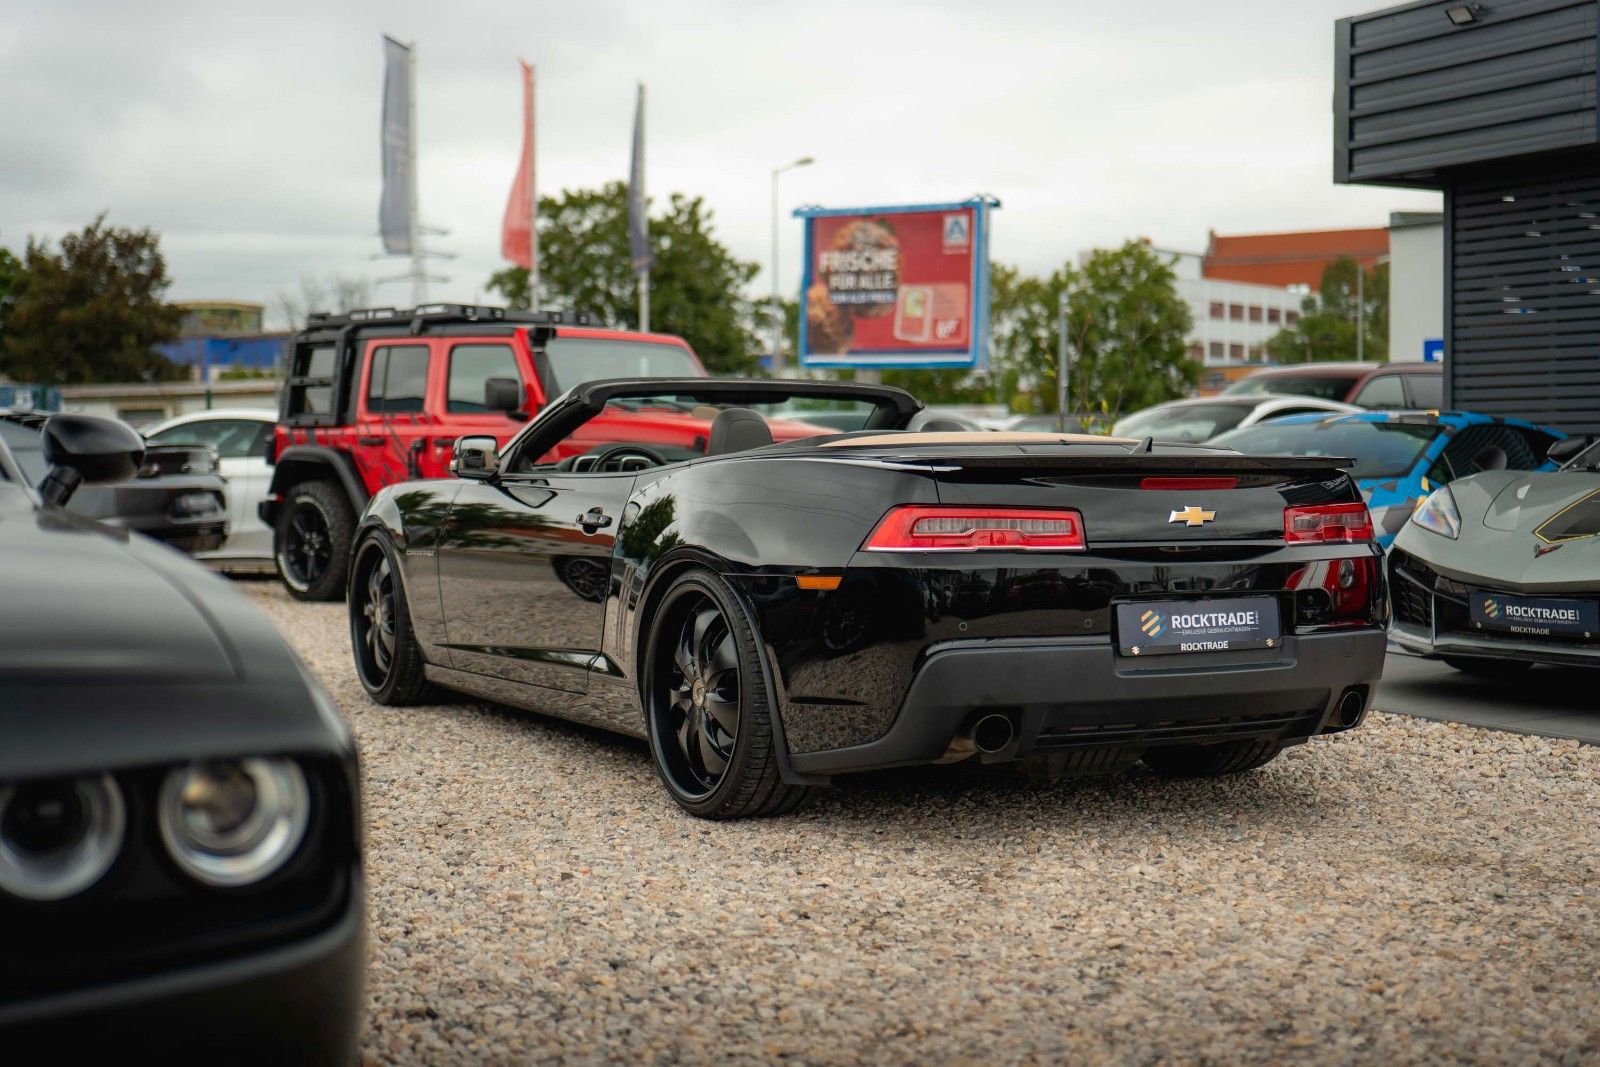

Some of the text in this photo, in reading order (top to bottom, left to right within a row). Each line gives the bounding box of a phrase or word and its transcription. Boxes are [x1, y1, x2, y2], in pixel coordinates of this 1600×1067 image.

[1505, 605, 1576, 620] ROCKTRADE
[1171, 611, 1254, 629] ROCKTRADE
[1510, 625, 1550, 635] ROCKTRADE
[1180, 640, 1229, 651] ROCKTRADE
